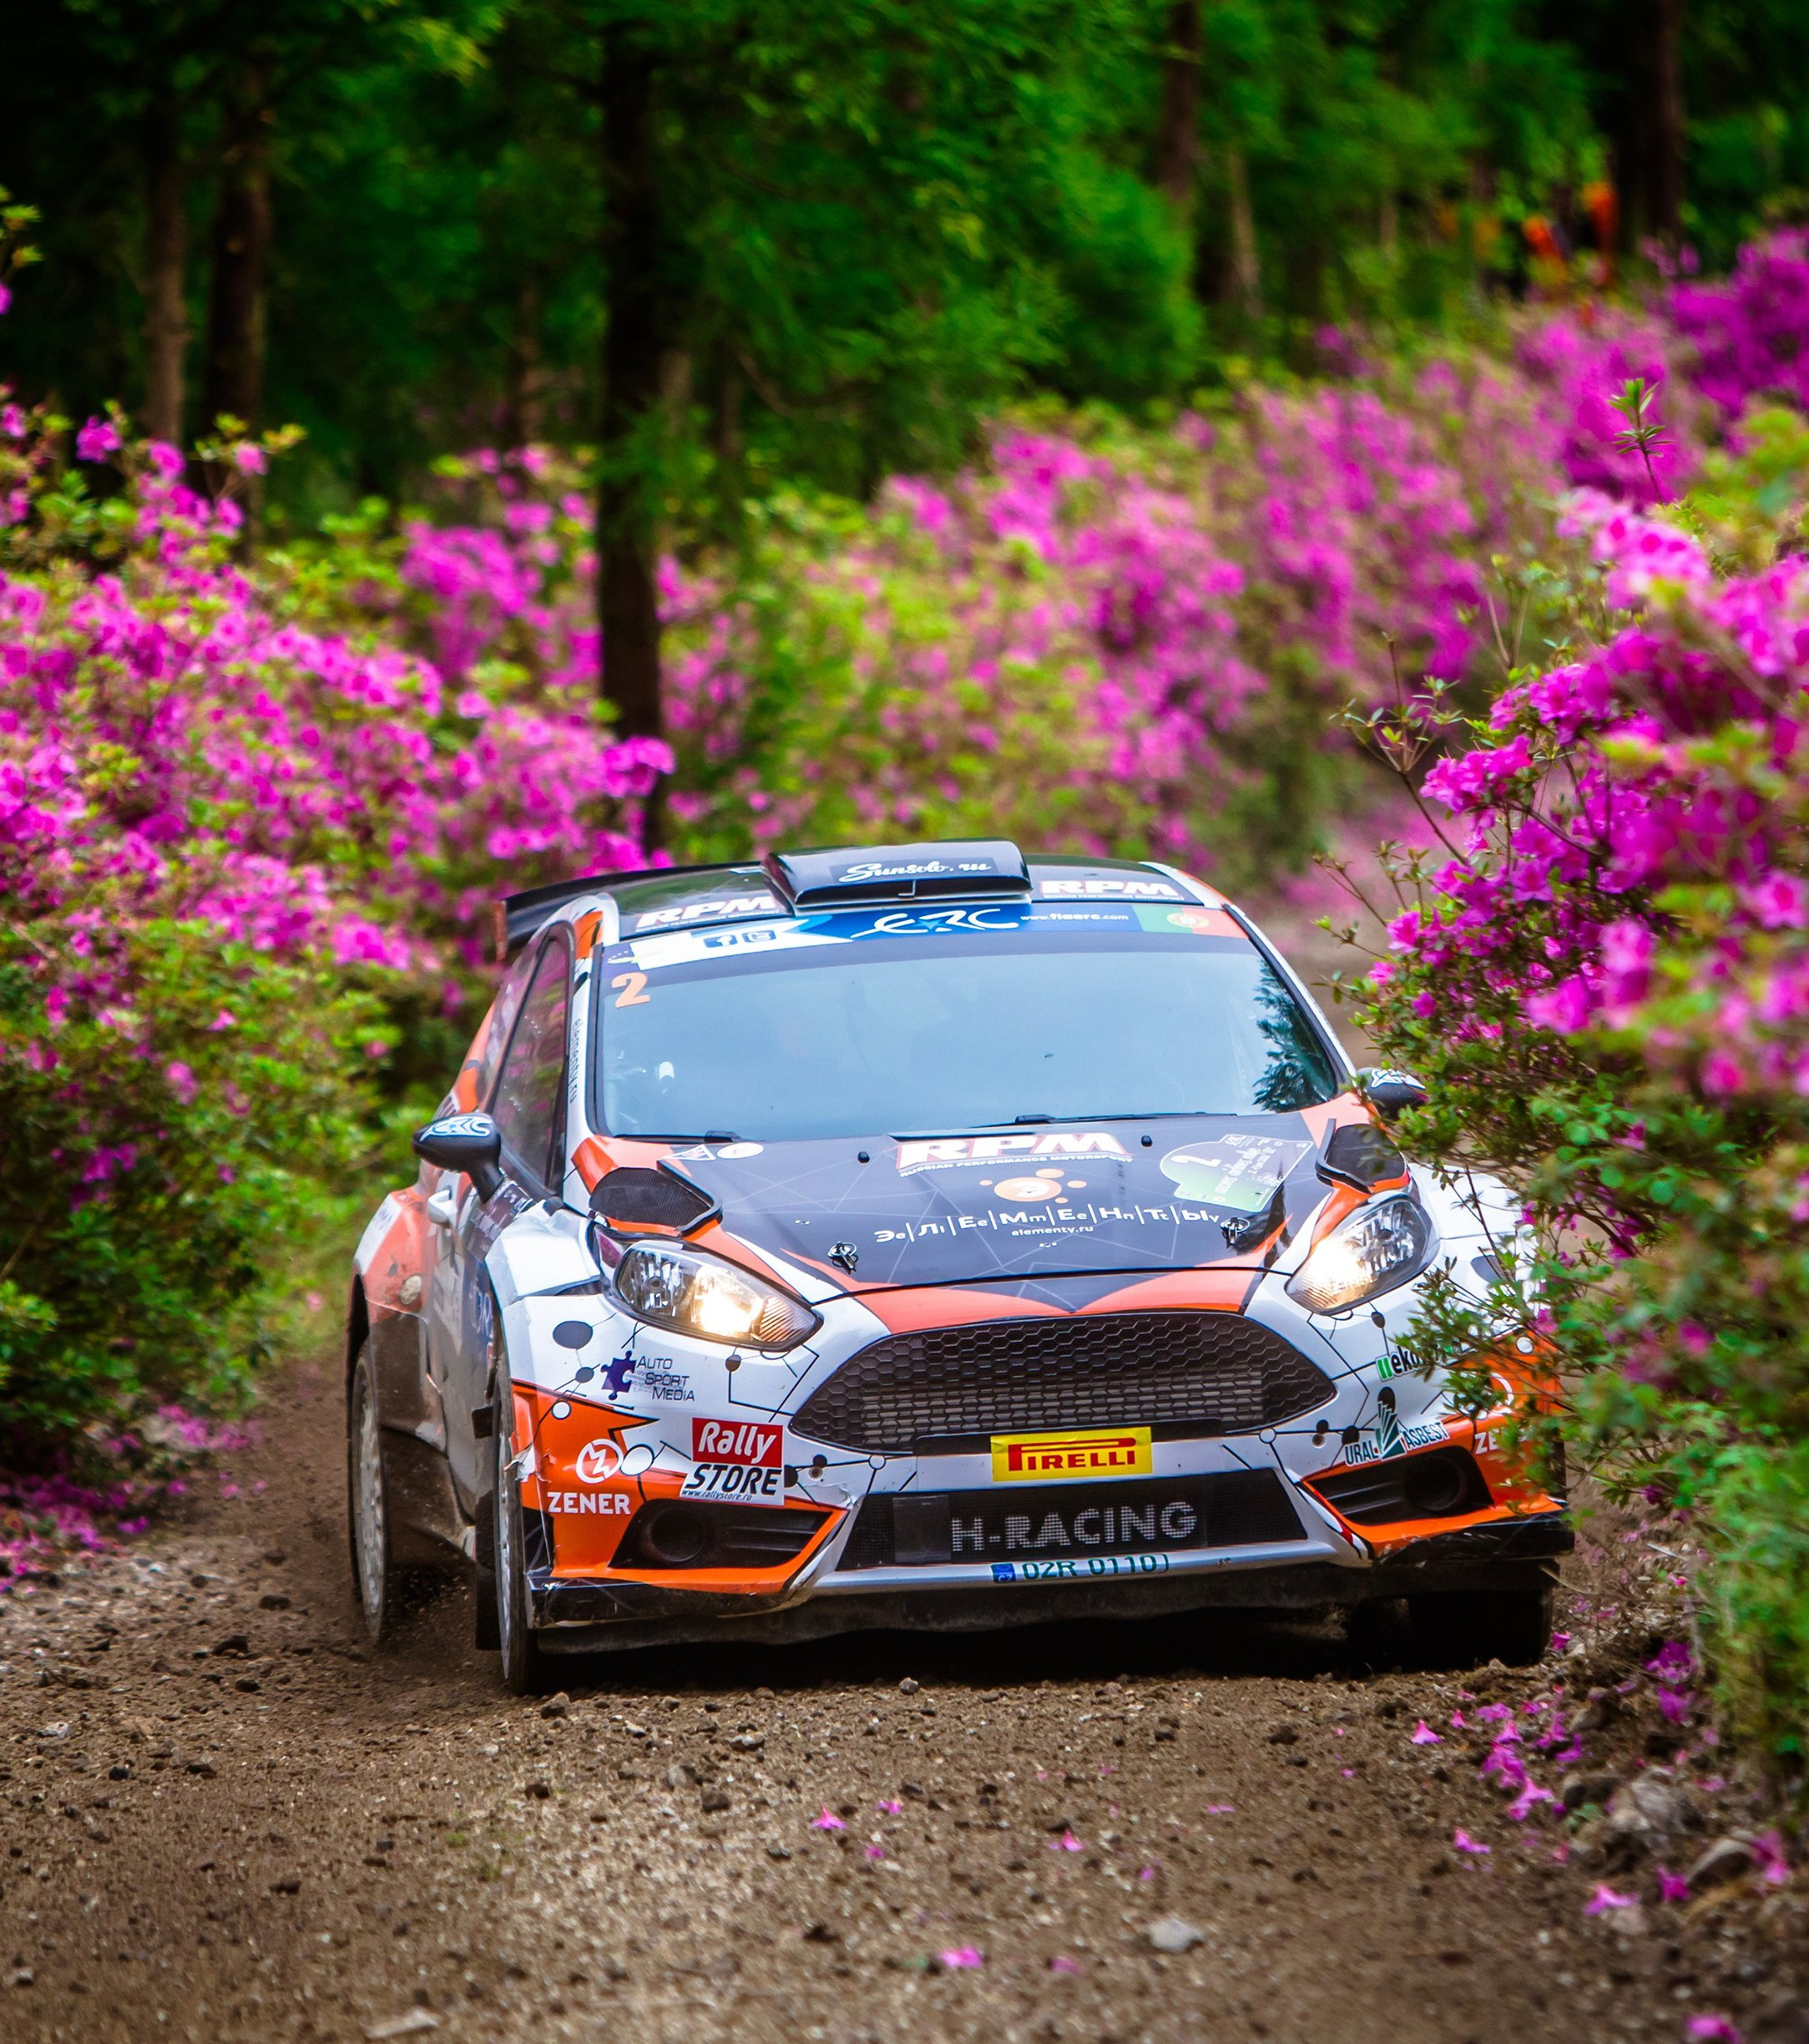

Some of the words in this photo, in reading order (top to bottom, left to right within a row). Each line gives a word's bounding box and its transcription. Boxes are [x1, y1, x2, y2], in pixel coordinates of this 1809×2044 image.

[1041, 880, 1180, 897] RPM
[636, 896, 777, 928] RPM
[851, 908, 1019, 938] ERC
[1019, 913, 1129, 921] www.fiaerc.com
[611, 972, 650, 1008] 2
[899, 1132, 1128, 1169] RPM
[900, 1162, 953, 1177] RUSSIAN
[956, 1156, 1048, 1168] PERFORMANCE
[1049, 1154, 1133, 1163] MOTORSPORT
[1012, 1226, 1094, 1237] elementy.ru
[637, 1355, 673, 1370] AUTO
[644, 1372, 690, 1387] SPORT
[698, 1421, 776, 1464] Rally
[1402, 1422, 1448, 1449] ASBEST
[1008, 1437, 1136, 1471] PIRELLI
[685, 1464, 782, 1495] STORE
[548, 1491, 631, 1515] ZENER
[950, 1501, 1197, 1551] H-RACING
